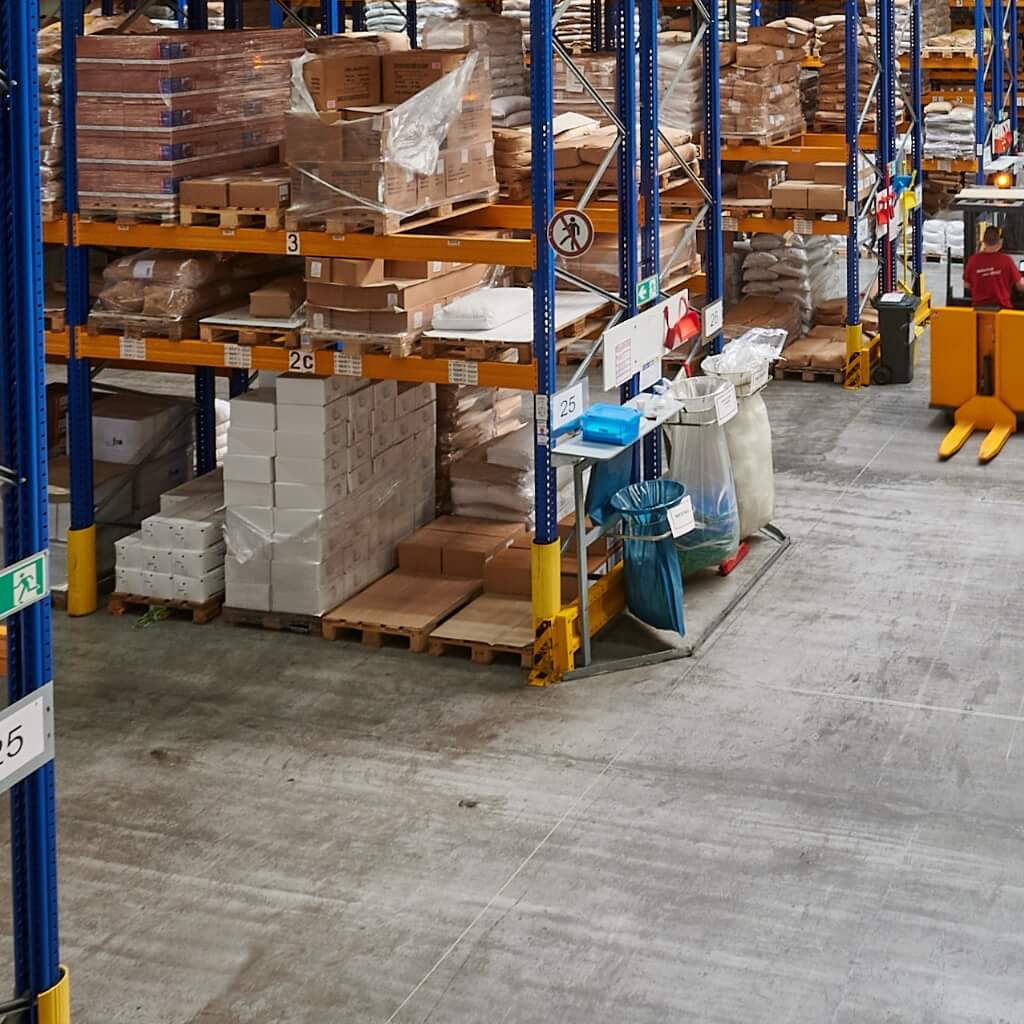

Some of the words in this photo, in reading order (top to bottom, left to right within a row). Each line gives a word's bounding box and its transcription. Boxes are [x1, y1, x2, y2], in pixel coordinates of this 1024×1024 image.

[288, 234, 298, 252] 3
[560, 395, 576, 418] 25
[0, 724, 23, 765] 5
